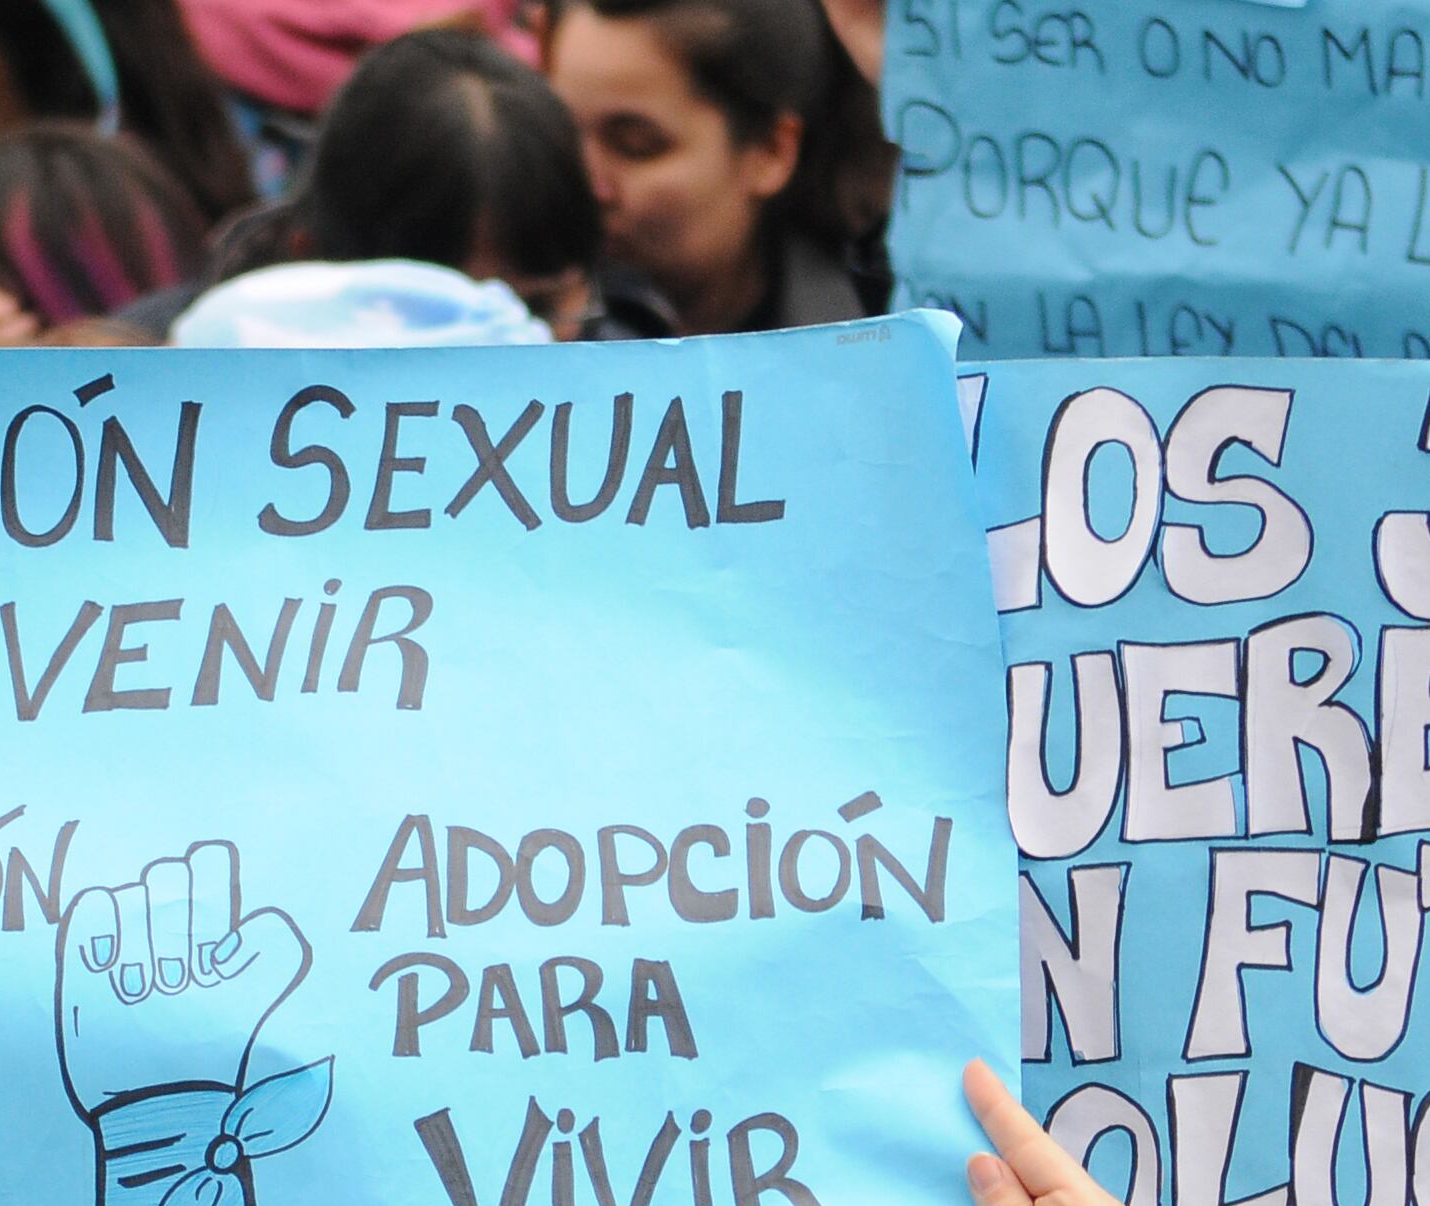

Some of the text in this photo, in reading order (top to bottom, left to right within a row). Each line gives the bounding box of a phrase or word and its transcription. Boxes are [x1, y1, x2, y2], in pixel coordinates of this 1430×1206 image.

[988, 0, 1106, 75] SER
[1139, 17, 1181, 79] O
[1203, 27, 1287, 89] NO
[893, 97, 1231, 249] PORQUE
[1277, 162, 1370, 257] YA
[1037, 287, 1105, 358] LA
[257, 384, 786, 537] SEXUAL
[370, 951, 699, 1061] PARA
[1018, 861, 1132, 1063] N
